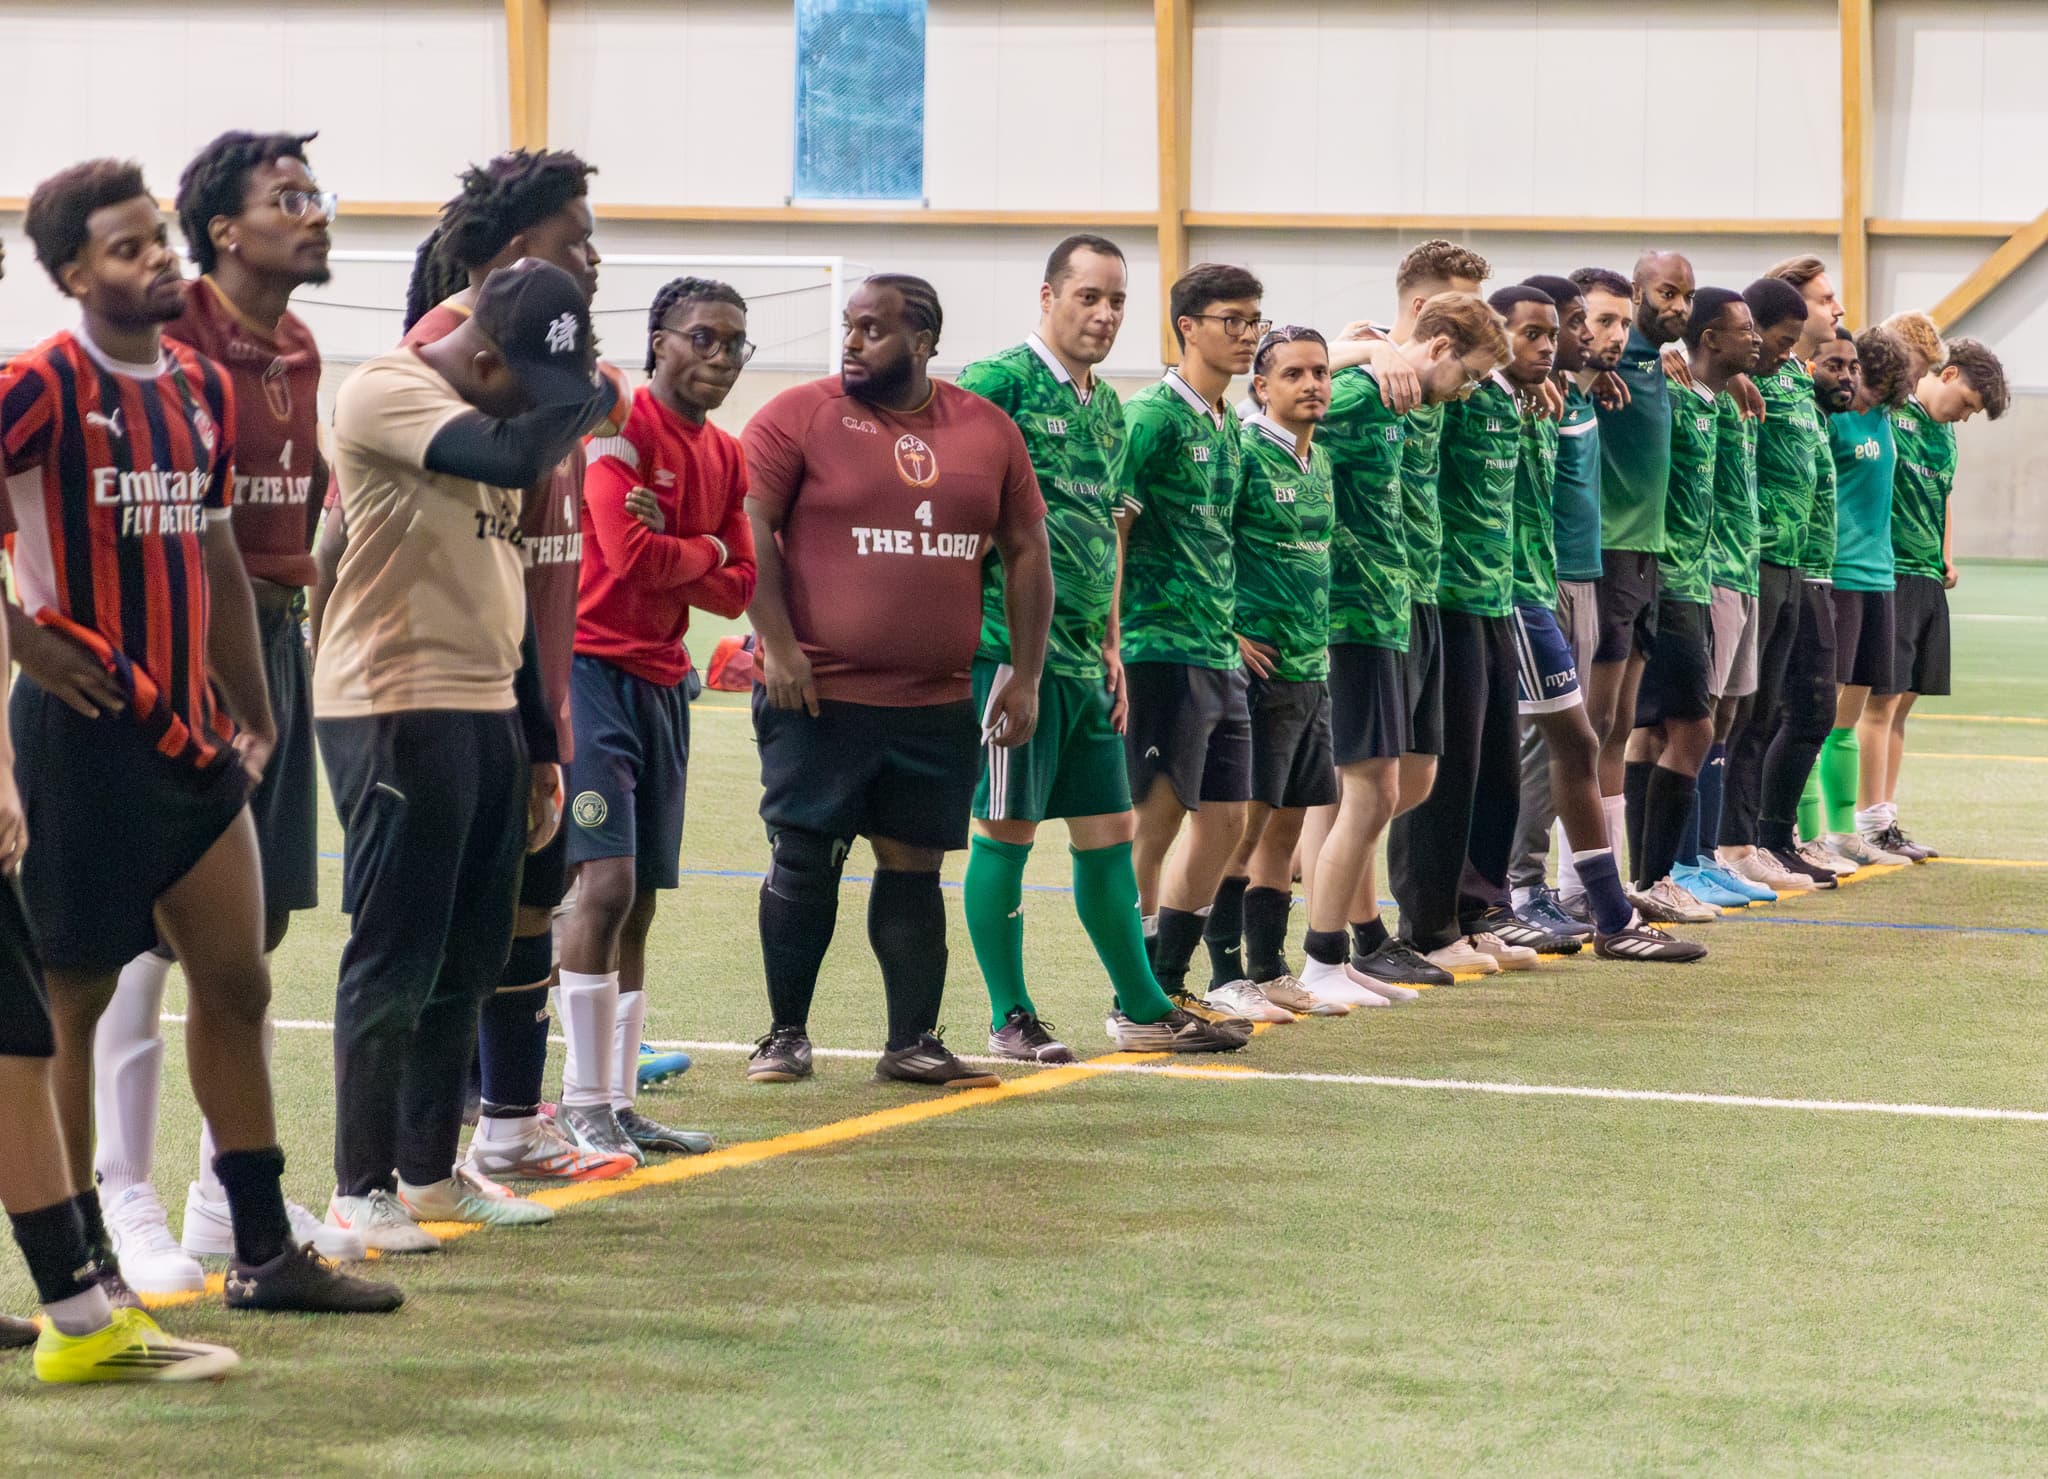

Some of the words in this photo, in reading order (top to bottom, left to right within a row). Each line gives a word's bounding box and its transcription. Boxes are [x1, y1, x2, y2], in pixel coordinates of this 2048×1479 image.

[1855, 437, 1880, 460] edp
[121, 505, 153, 537] FLY
[914, 500, 933, 527] 4
[851, 527, 914, 556] THE
[920, 532, 980, 561] LORD
